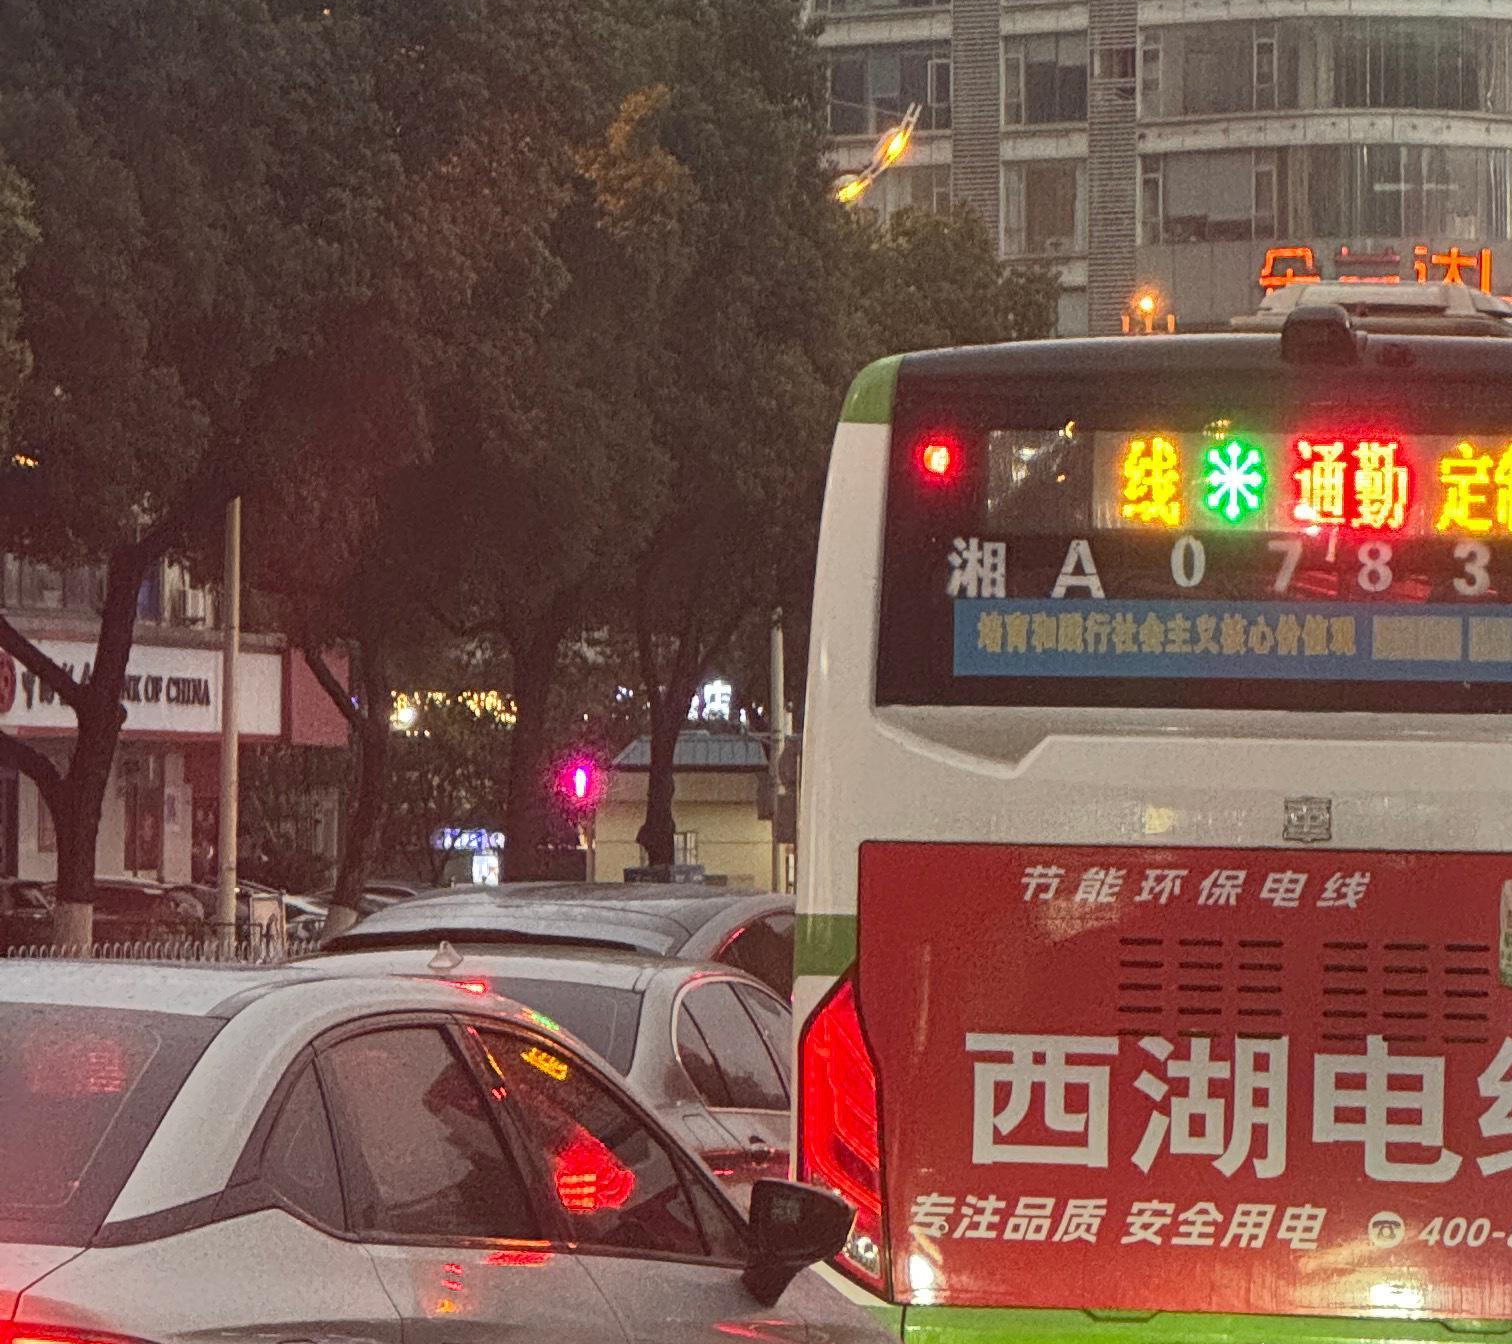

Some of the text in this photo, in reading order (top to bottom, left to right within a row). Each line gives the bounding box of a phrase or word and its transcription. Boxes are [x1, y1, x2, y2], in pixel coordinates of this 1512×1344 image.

[1293, 440, 1408, 529] 通勤
[143, 674, 163, 703] OF
[166, 677, 211, 705] CHINA
[1019, 864, 1371, 909] 节能环保电线
[909, 1192, 1109, 1245] 专注品质
[1119, 1198, 1329, 1250] 安全用电
